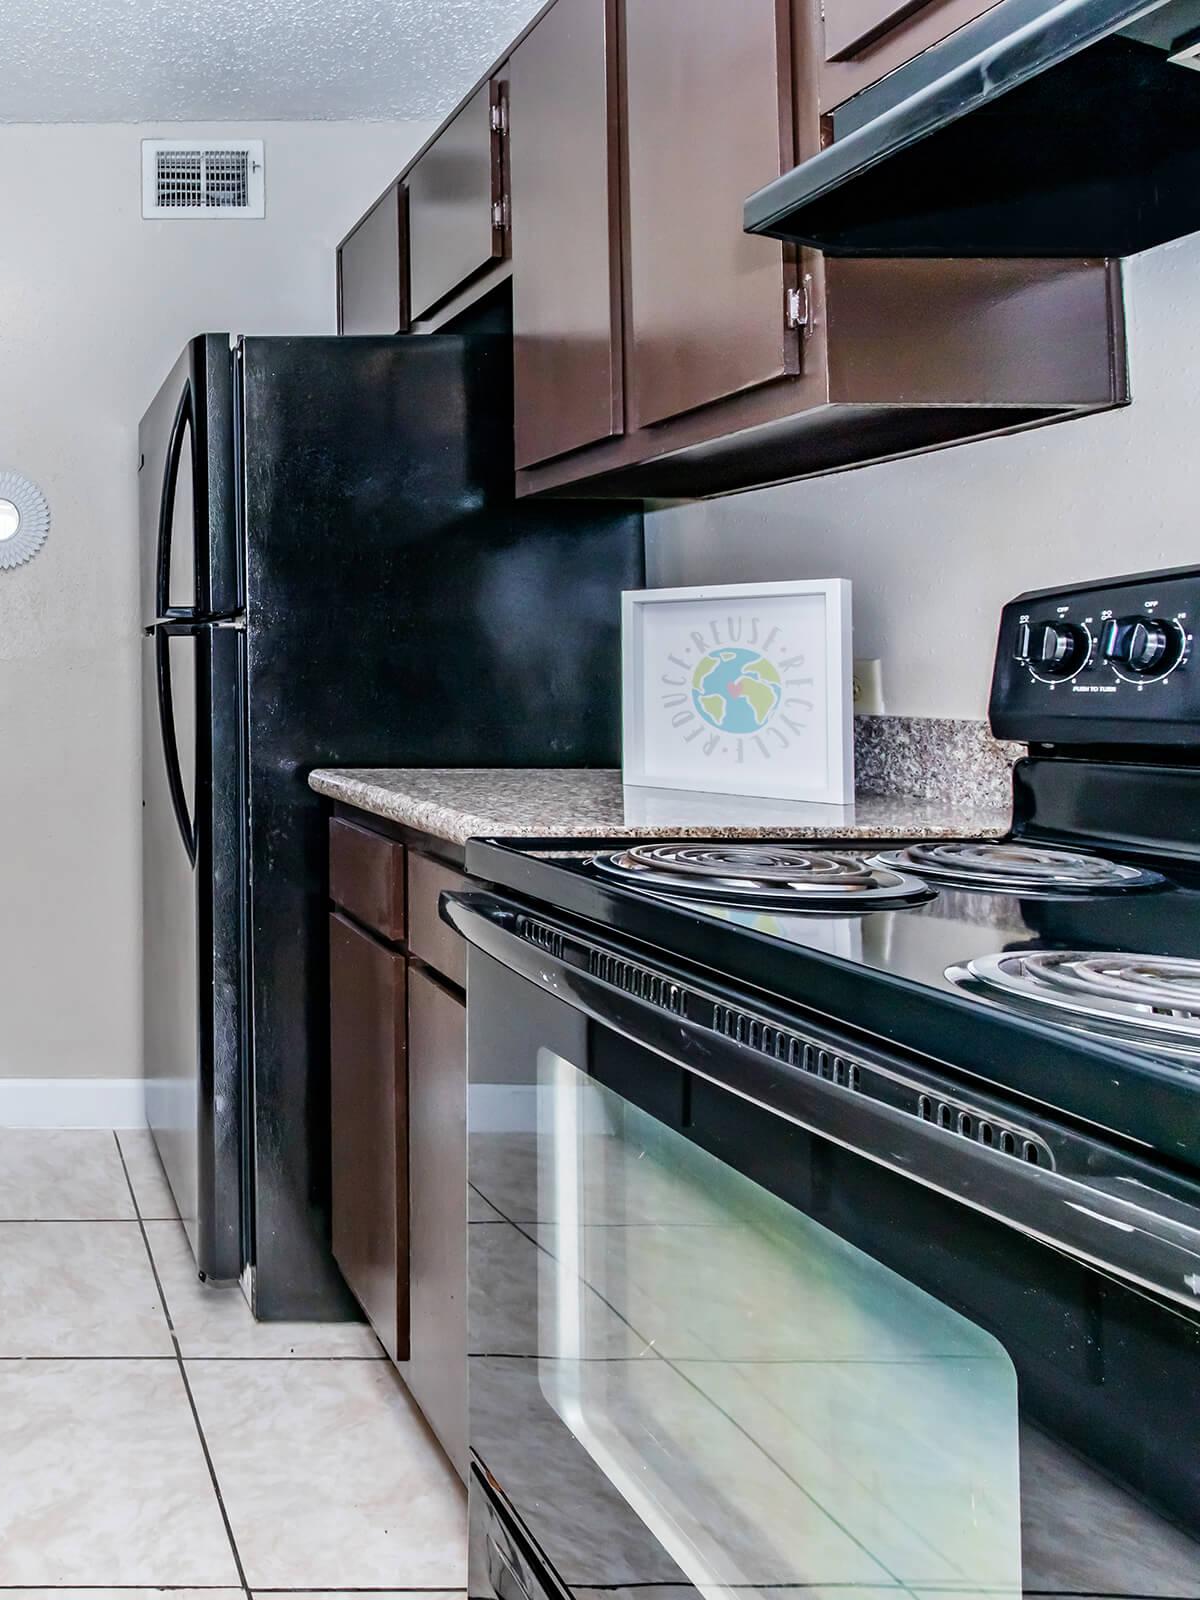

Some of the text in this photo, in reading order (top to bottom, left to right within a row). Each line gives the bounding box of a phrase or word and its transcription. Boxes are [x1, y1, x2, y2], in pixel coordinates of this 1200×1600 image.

[661, 616, 814, 764] REDUCE REUSE RECYCLE
